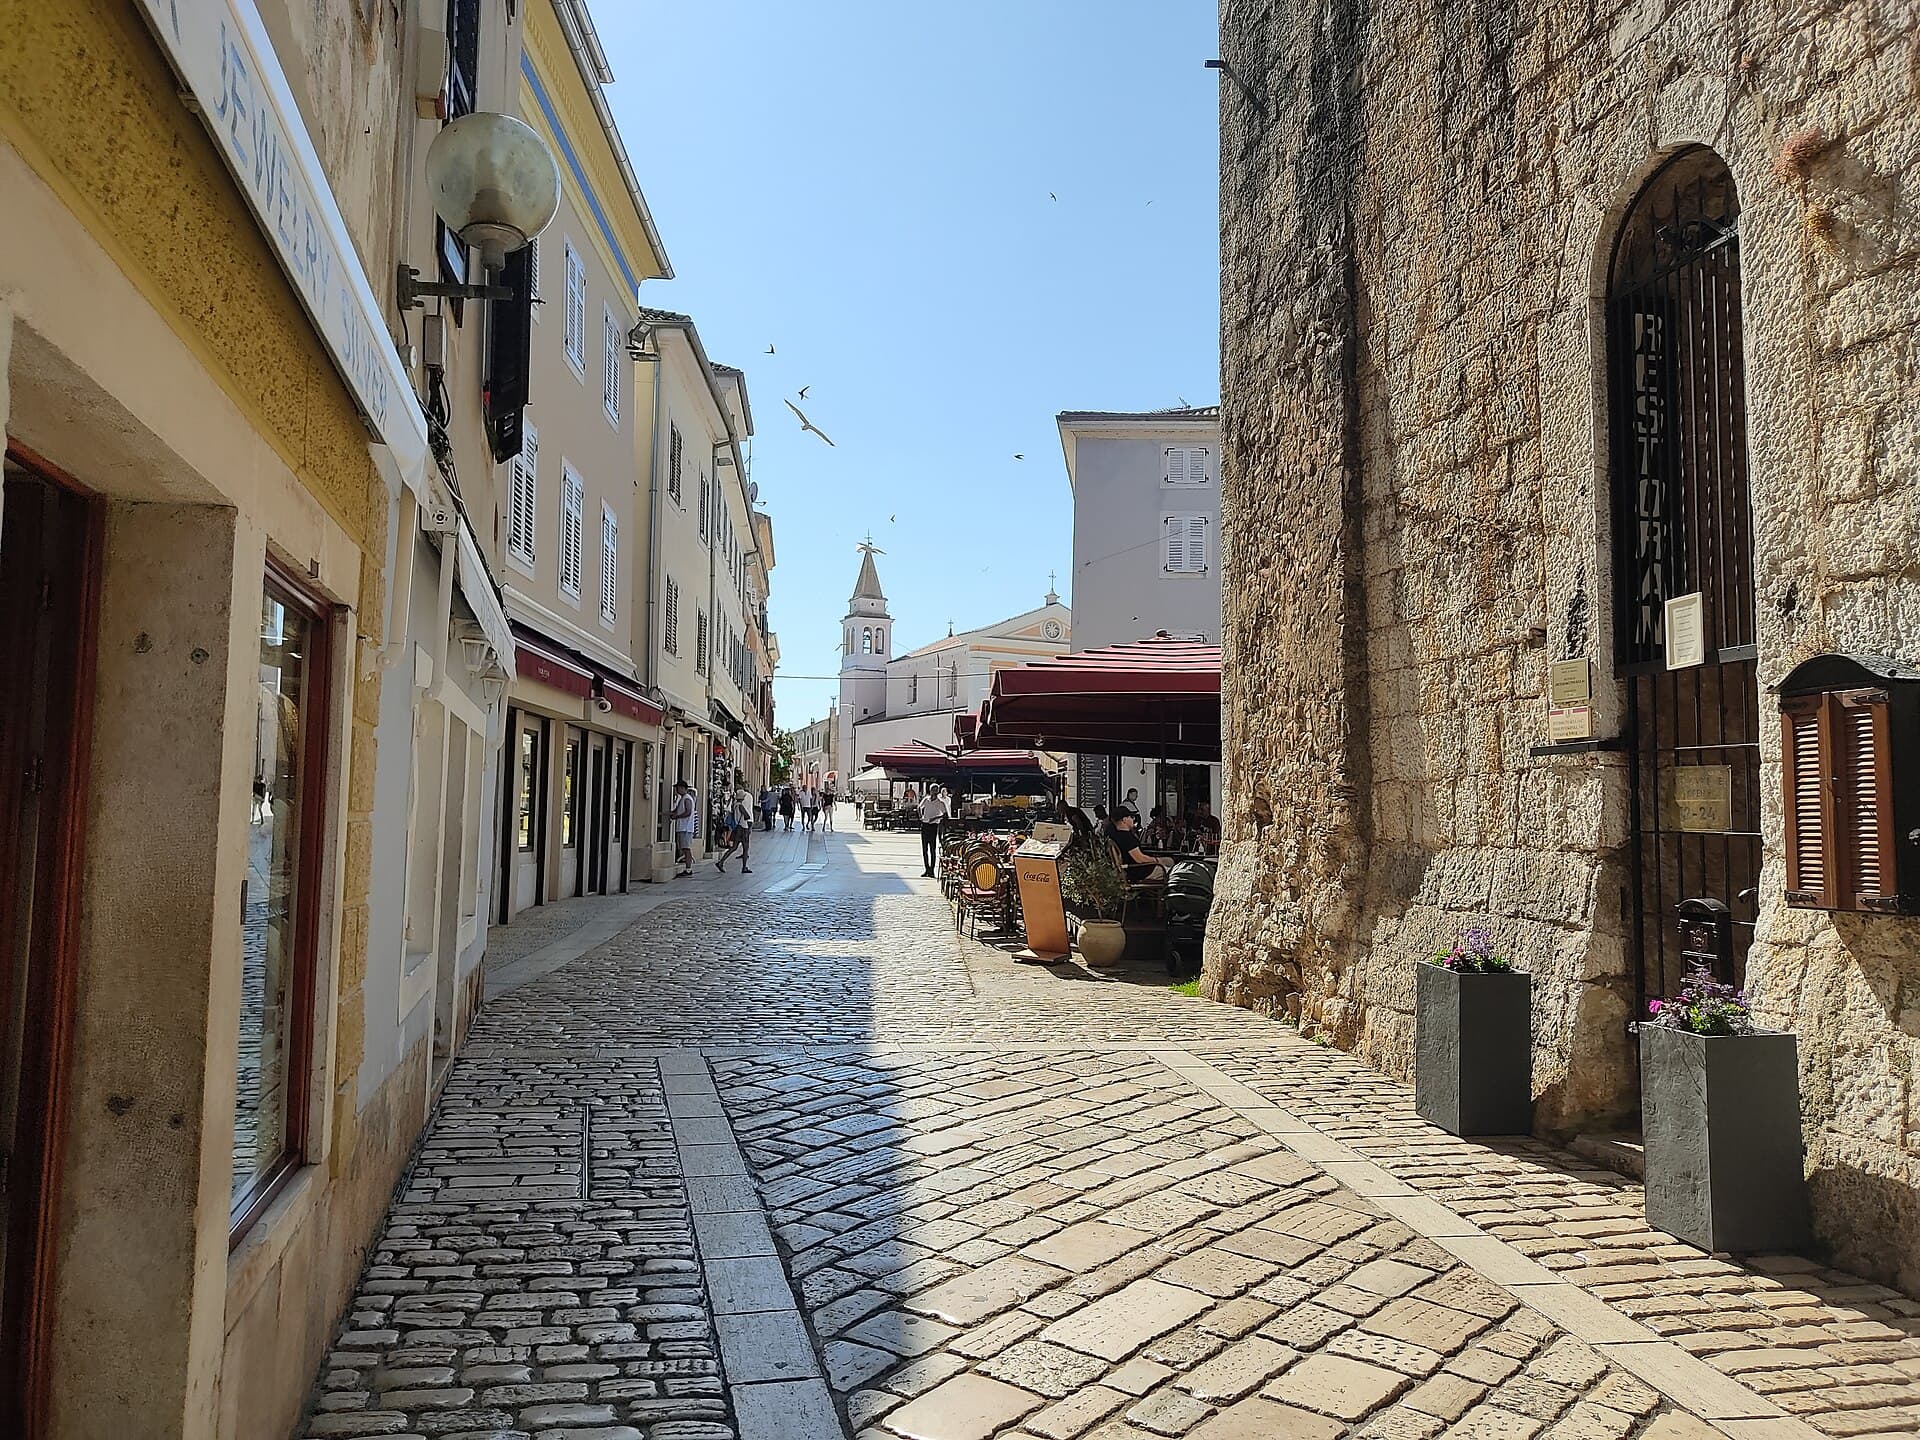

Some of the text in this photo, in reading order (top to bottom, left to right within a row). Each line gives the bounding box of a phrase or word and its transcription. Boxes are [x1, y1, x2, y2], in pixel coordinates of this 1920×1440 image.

[213, 20, 387, 432] JEWELRY SILVER
[1634, 313, 1664, 645] RESTORAN
